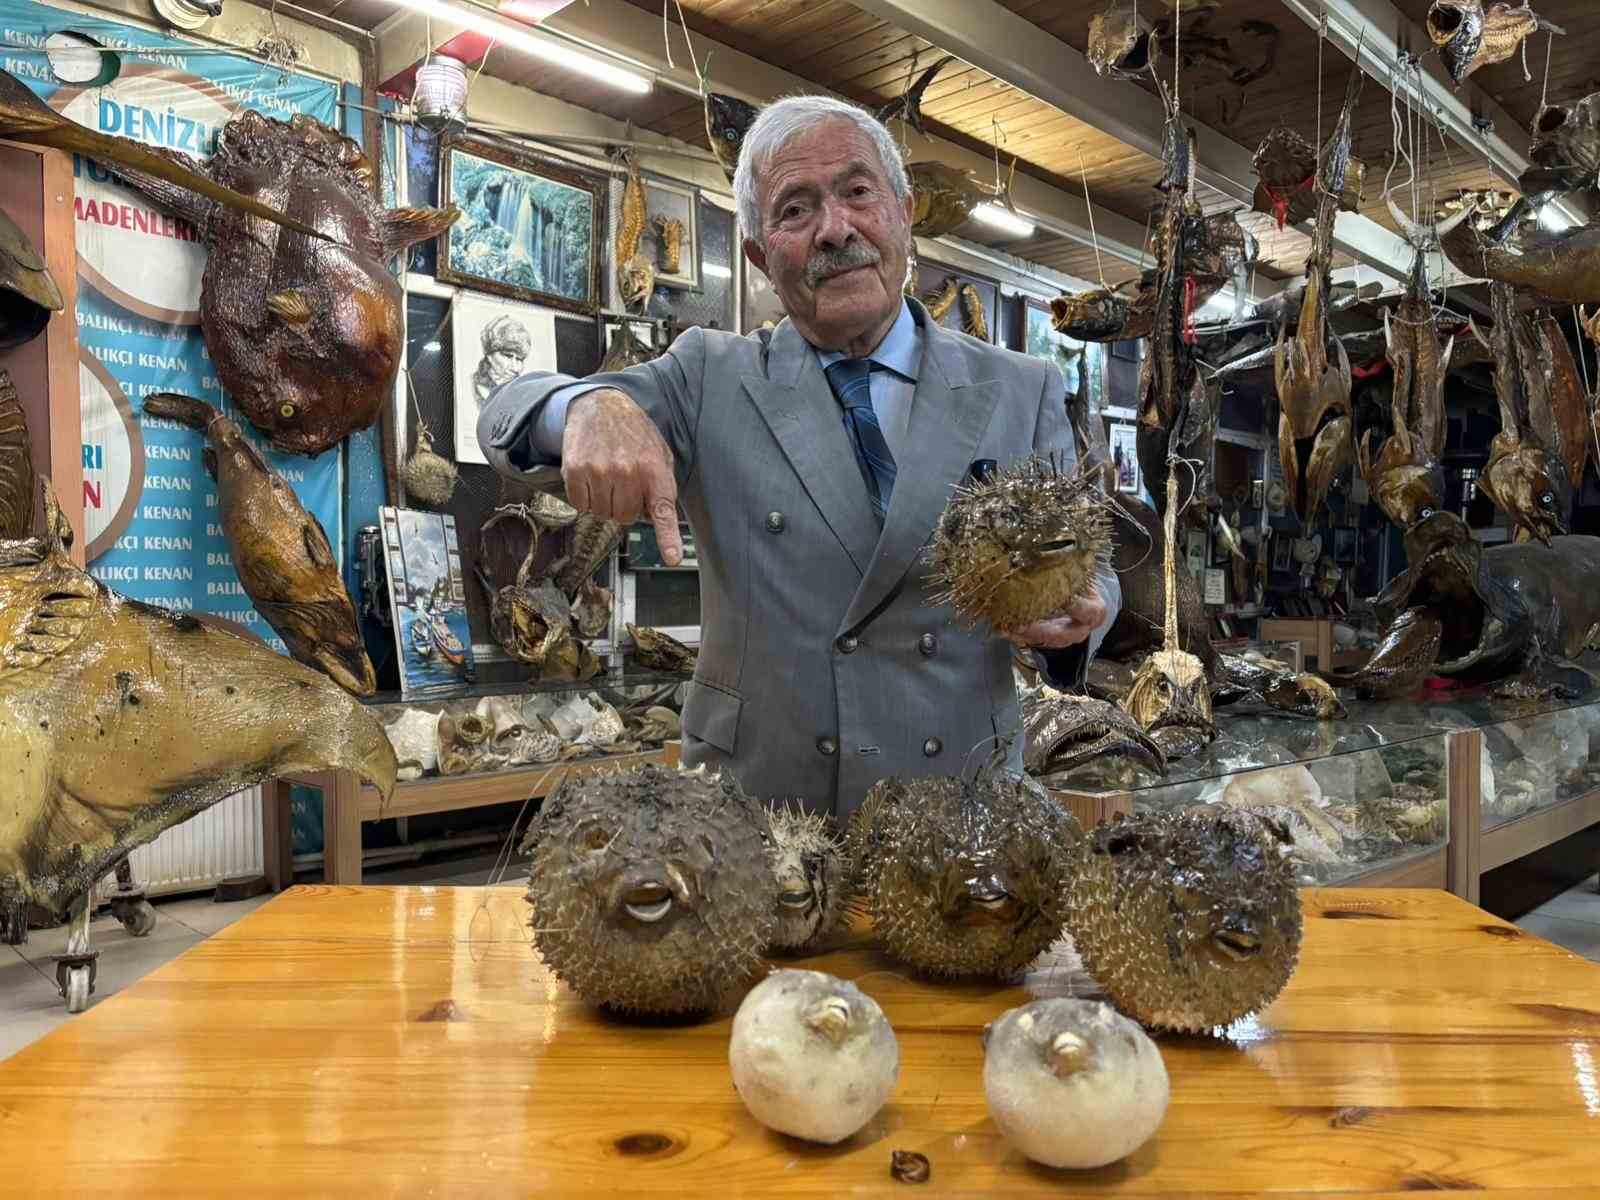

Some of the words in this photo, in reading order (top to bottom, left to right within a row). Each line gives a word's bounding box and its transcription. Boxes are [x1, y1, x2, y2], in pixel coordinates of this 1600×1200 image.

[5, 57, 57, 82] KENA
[75, 312, 132, 335] BALIKÇI
[138, 353, 187, 372] KENAN
[143, 445, 191, 460] KENAN
[143, 476, 192, 490] KENAN
[143, 506, 192, 520] KENAN
[144, 536, 192, 551] KENAN
[144, 567, 192, 580] KENAN
